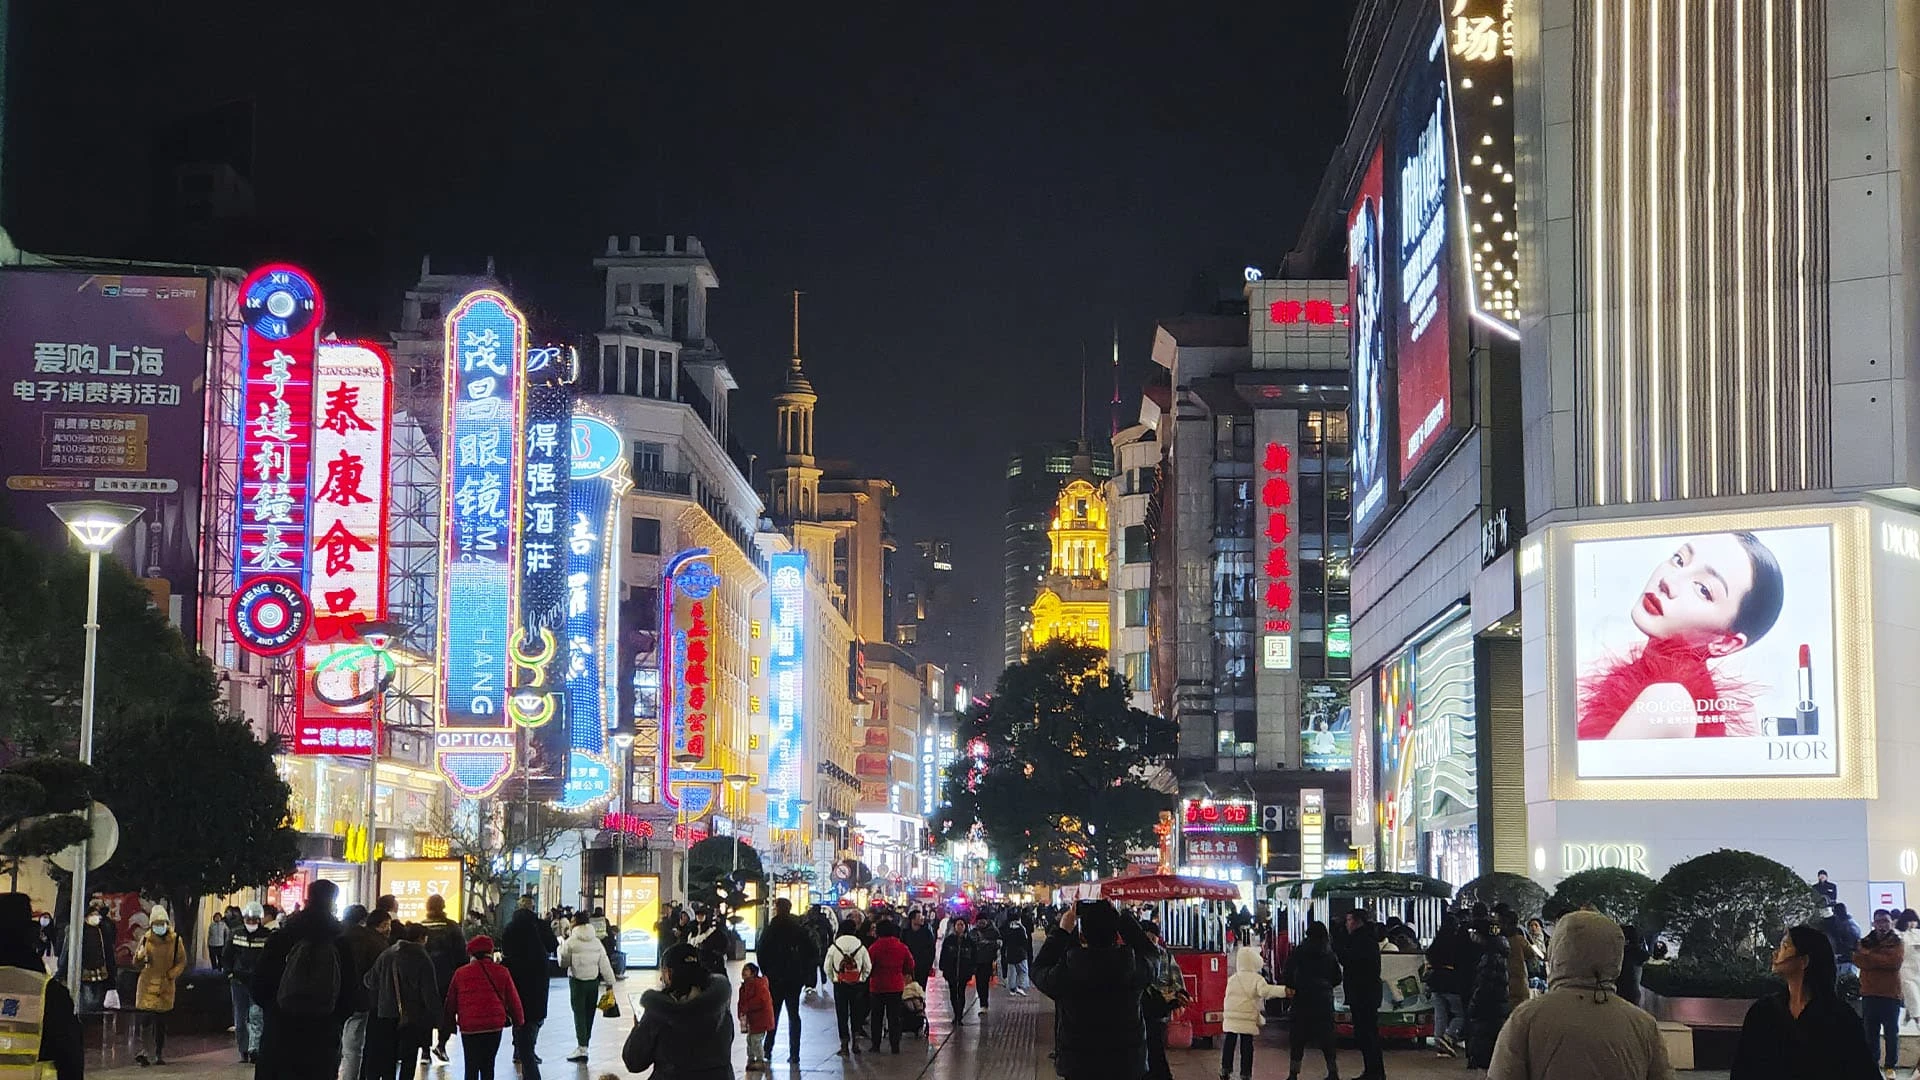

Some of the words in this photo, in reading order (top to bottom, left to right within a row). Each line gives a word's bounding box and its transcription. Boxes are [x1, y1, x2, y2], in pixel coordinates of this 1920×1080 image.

[1270, 299, 1350, 326] 新雅
[33, 342, 164, 377] 爱购上海
[12, 380, 181, 406] 电子消费券活动
[455, 328, 507, 518] 茂昌眼镜
[315, 380, 378, 641] 泰康食品
[240, 583, 272, 607] HENG
[274, 583, 300, 607] DALI
[237, 611, 253, 638] CLOCK
[256, 637, 273, 646] AND
[275, 612, 302, 643] WATCHES
[1265, 620, 1291, 632] 1926
[1637, 700, 1693, 714] ROUGE
[1695, 698, 1738, 713] DIOR
[437, 732, 513, 748] OPTICAL
[1414, 714, 1451, 771] SEPHORA
[1767, 741, 1829, 761] DIOR
[1562, 843, 1650, 873] DIOR
[390, 880, 421, 896] 智界
[426, 880, 450, 896] S7
[636, 888, 651, 900] S7
